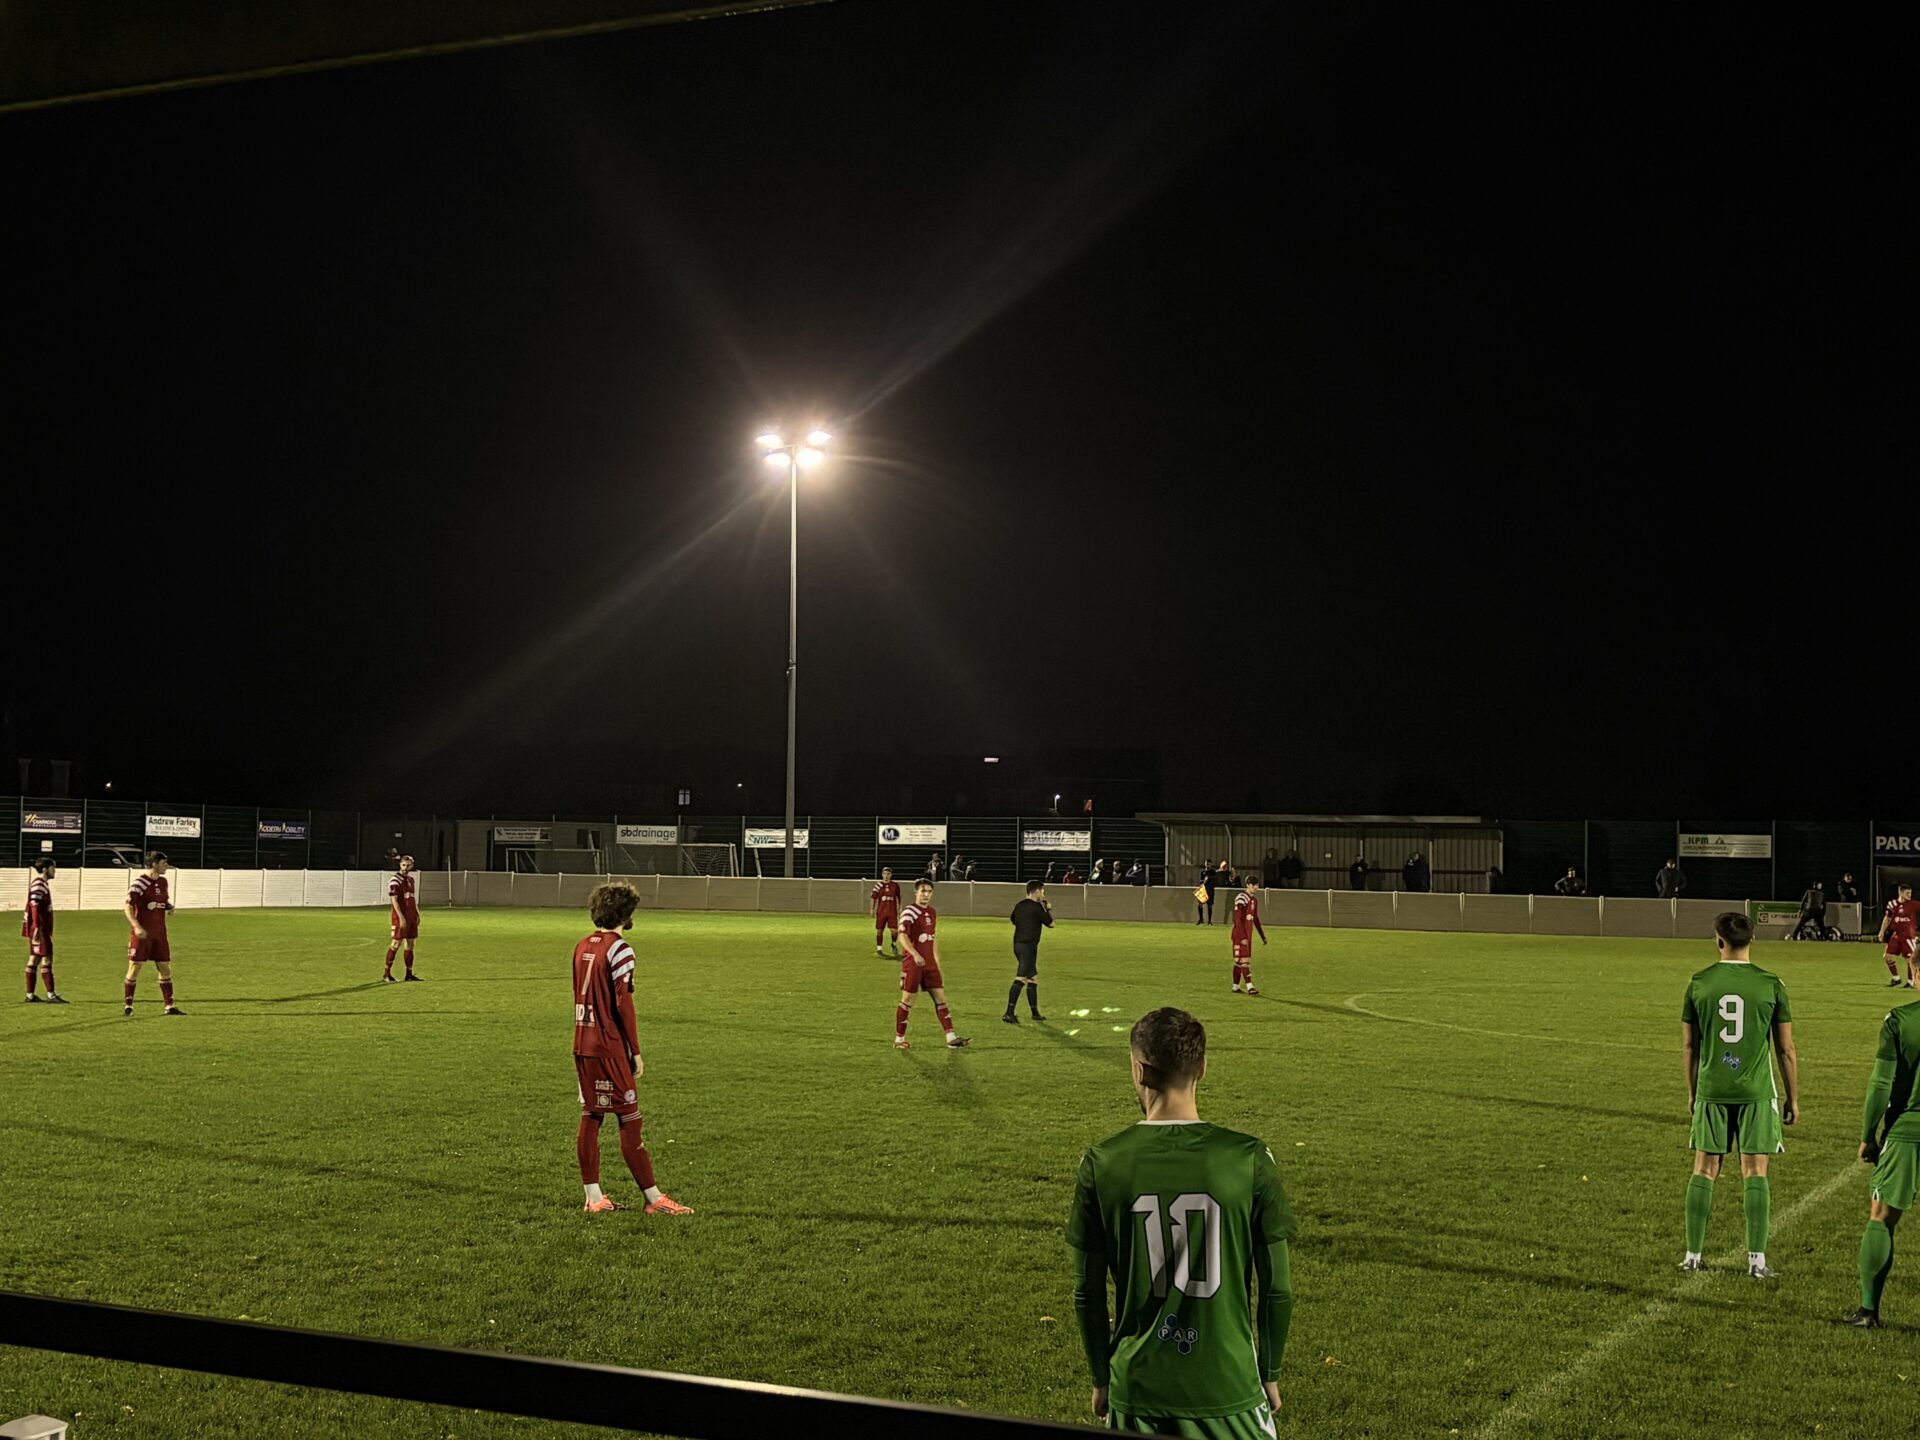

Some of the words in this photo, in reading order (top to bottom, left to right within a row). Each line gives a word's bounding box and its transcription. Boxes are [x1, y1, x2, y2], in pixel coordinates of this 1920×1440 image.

[148, 817, 175, 825] Andrew
[176, 818, 197, 828] Farley
[282, 822, 305, 834] MOBILITY
[620, 826, 676, 841] sbdrainage
[1875, 835, 1911, 851] PAR
[582, 953, 596, 996] 7
[1718, 994, 1745, 1044] 9
[1130, 1191, 1222, 1300] 10
[1160, 1326, 1197, 1341] PAR
